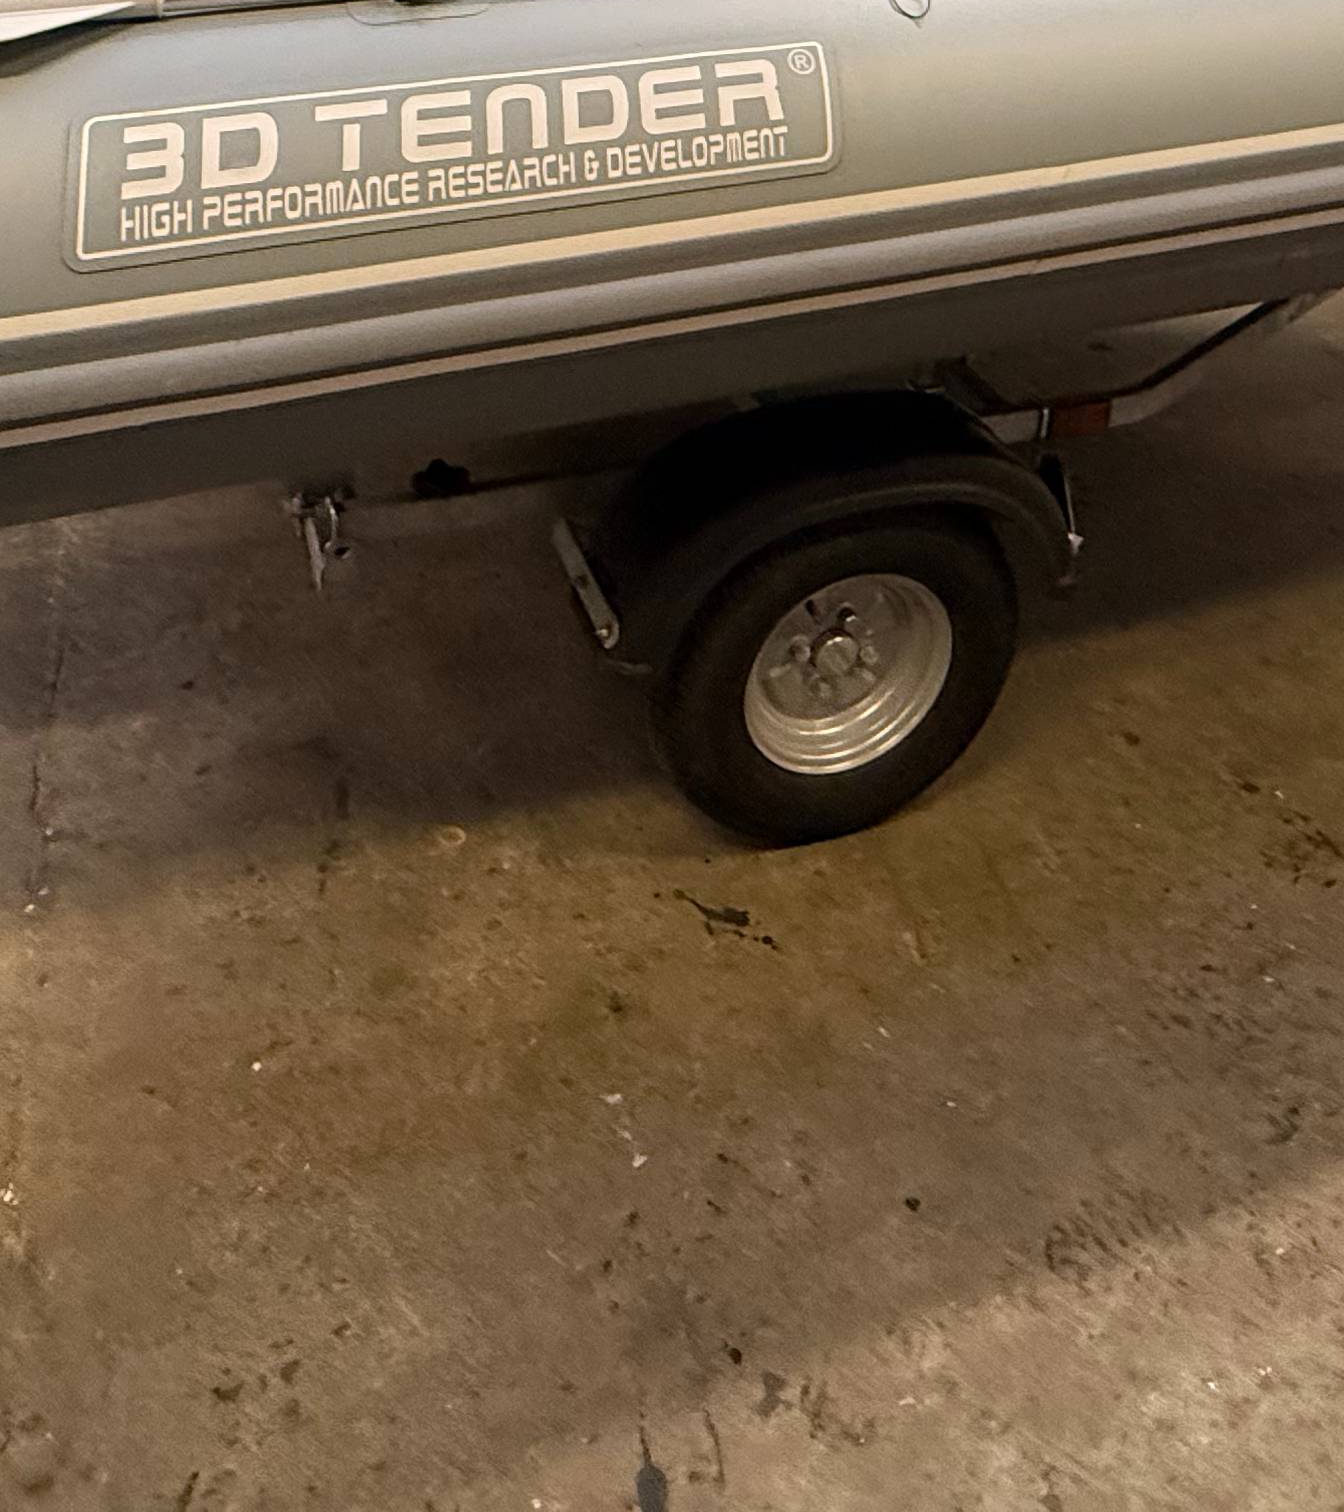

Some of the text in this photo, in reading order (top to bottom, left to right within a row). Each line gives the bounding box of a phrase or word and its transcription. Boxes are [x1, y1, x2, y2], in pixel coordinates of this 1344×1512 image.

[120, 111, 279, 200] 3D
[314, 58, 785, 172] TENDER
[120, 126, 789, 243] HIGH PERFORMANCE RESEARCH & DEVELOPMENT
